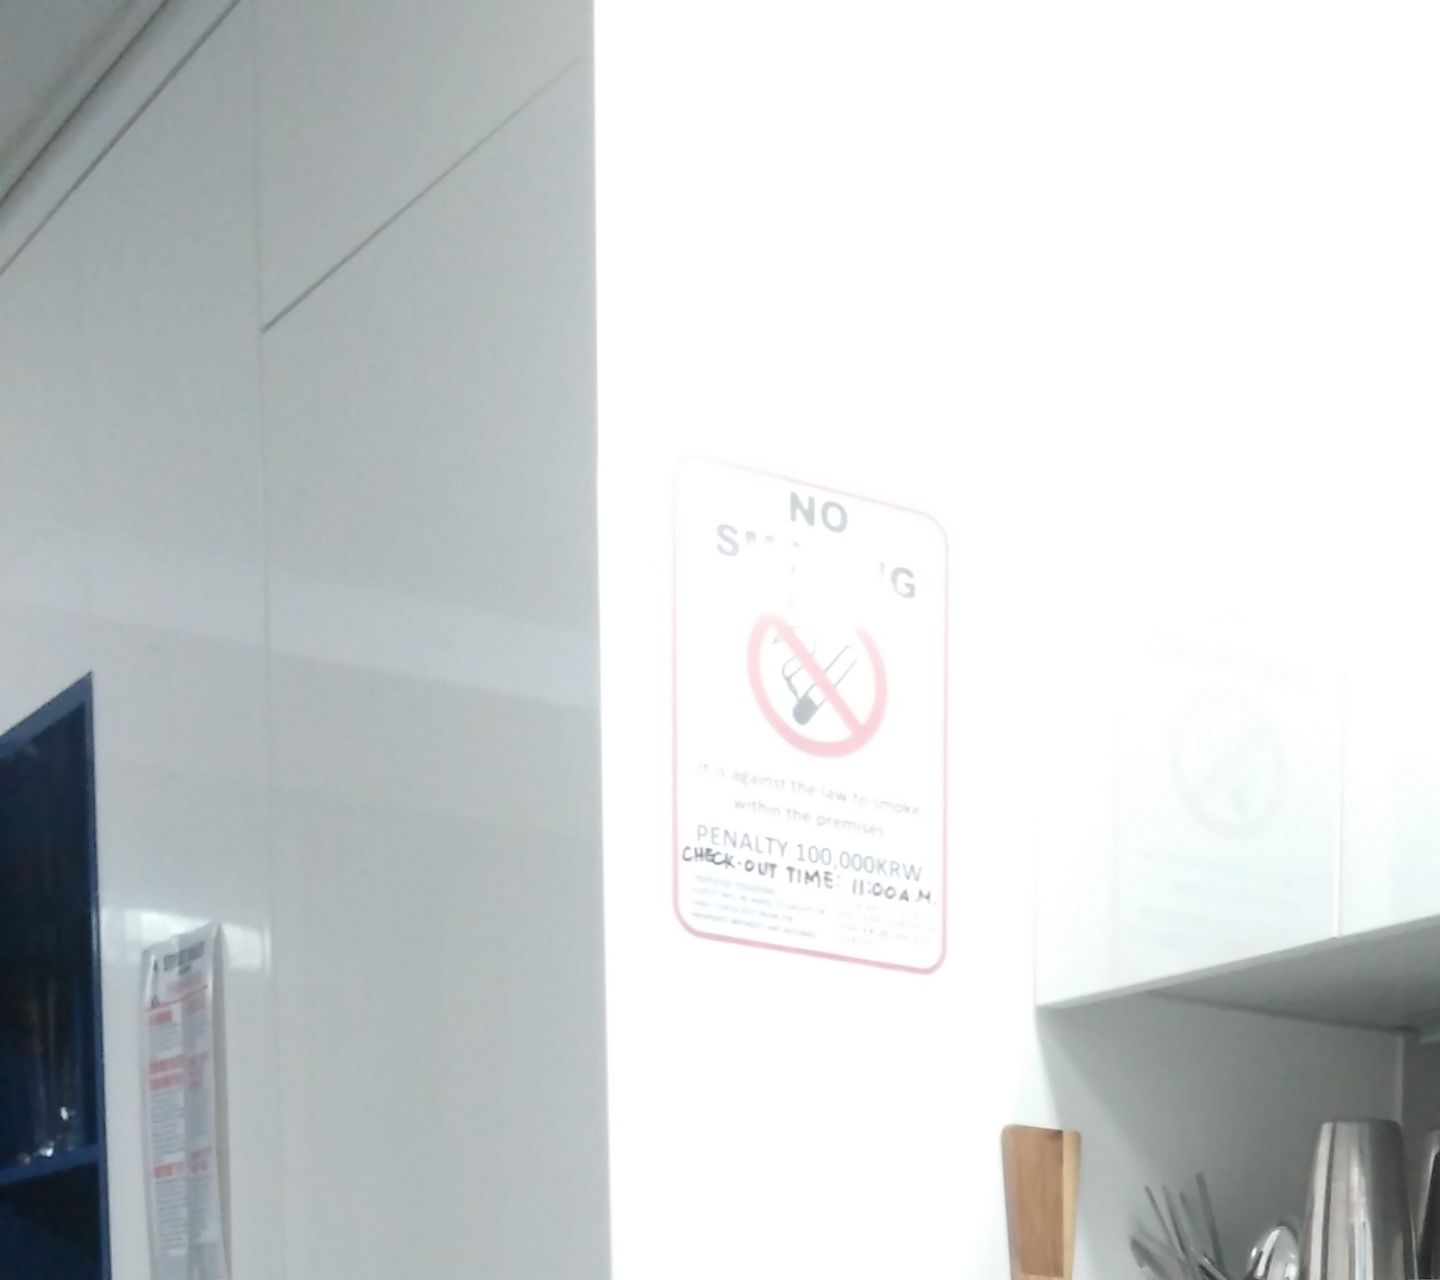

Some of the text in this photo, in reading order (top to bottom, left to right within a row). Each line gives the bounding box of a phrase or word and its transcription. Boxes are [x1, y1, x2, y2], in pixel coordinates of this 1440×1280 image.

[790, 491, 848, 533] NO
[733, 769, 785, 790] against
[792, 780, 816, 796] the
[822, 784, 848, 803] law
[874, 798, 920, 816] smoke
[734, 798, 780, 817] within
[787, 808, 811, 823] the
[696, 824, 922, 882] PENALTY 100,000KRW
